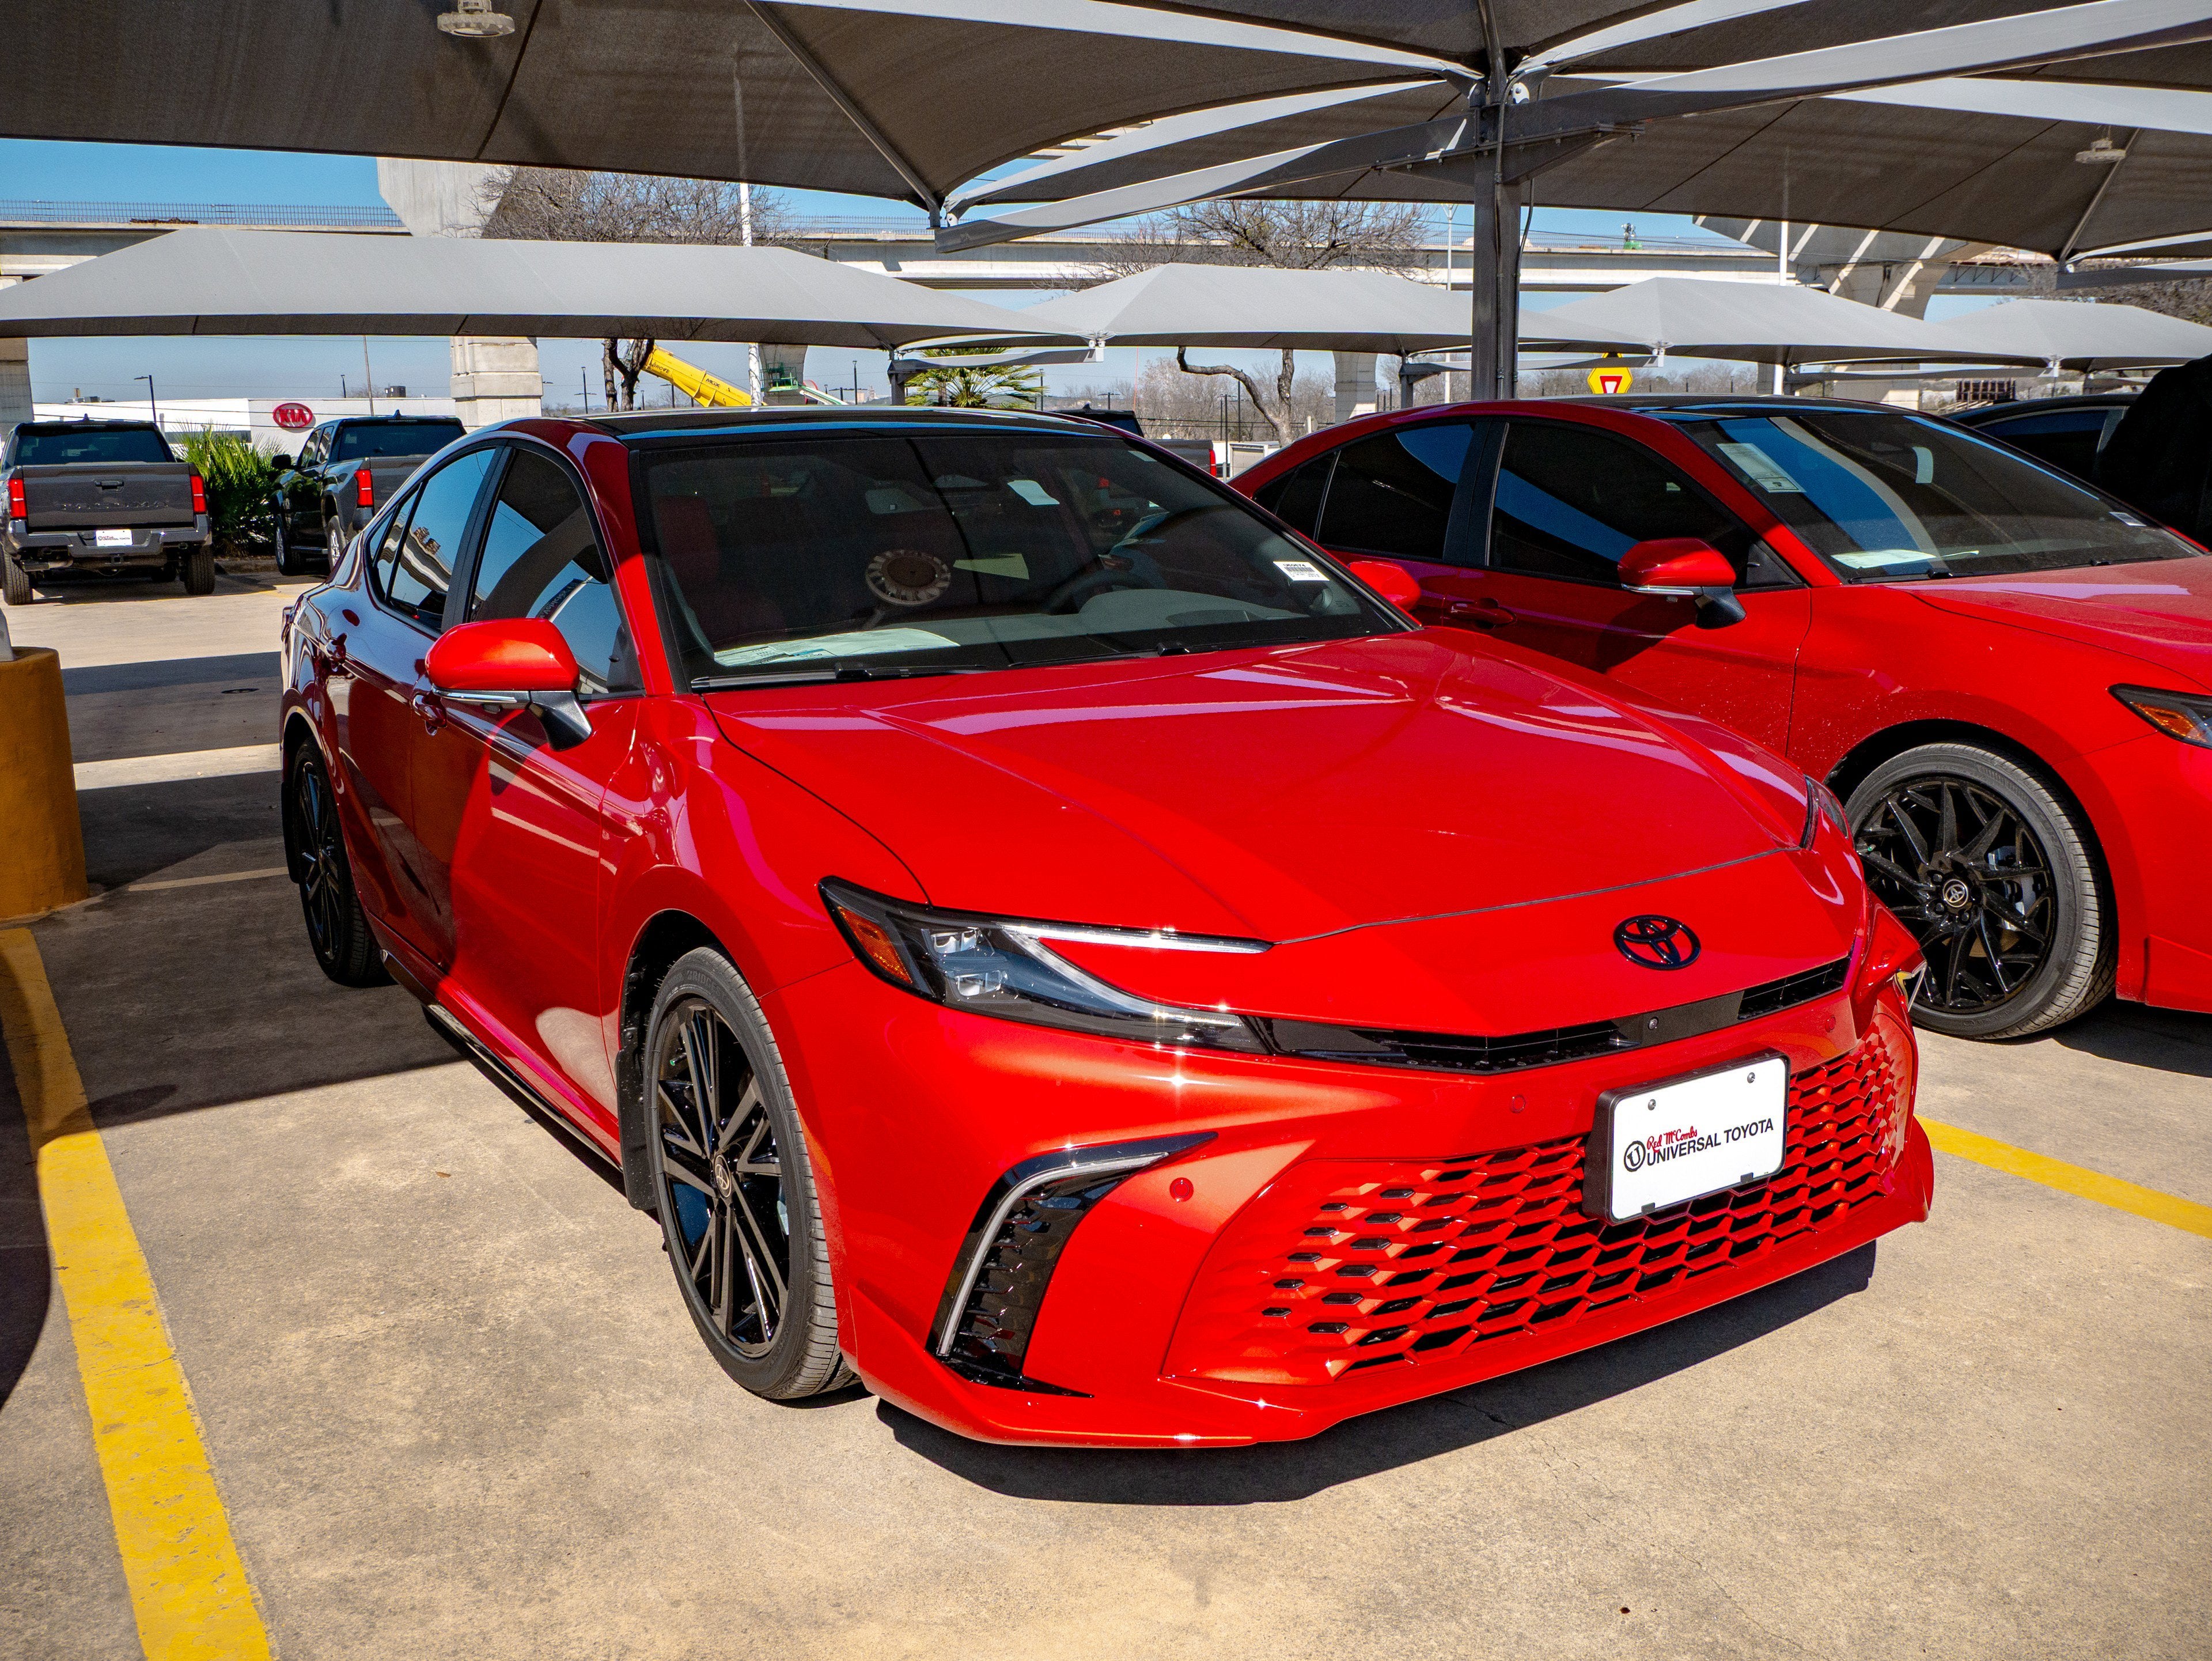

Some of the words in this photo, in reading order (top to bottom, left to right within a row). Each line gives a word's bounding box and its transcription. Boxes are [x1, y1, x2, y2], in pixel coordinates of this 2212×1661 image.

[652, 363, 670, 373] GROVE
[1647, 1133, 1721, 1166] UNIVERSAL
[1724, 1118, 1774, 1144] TOYOTA
[1647, 1134, 1662, 1153] Red
